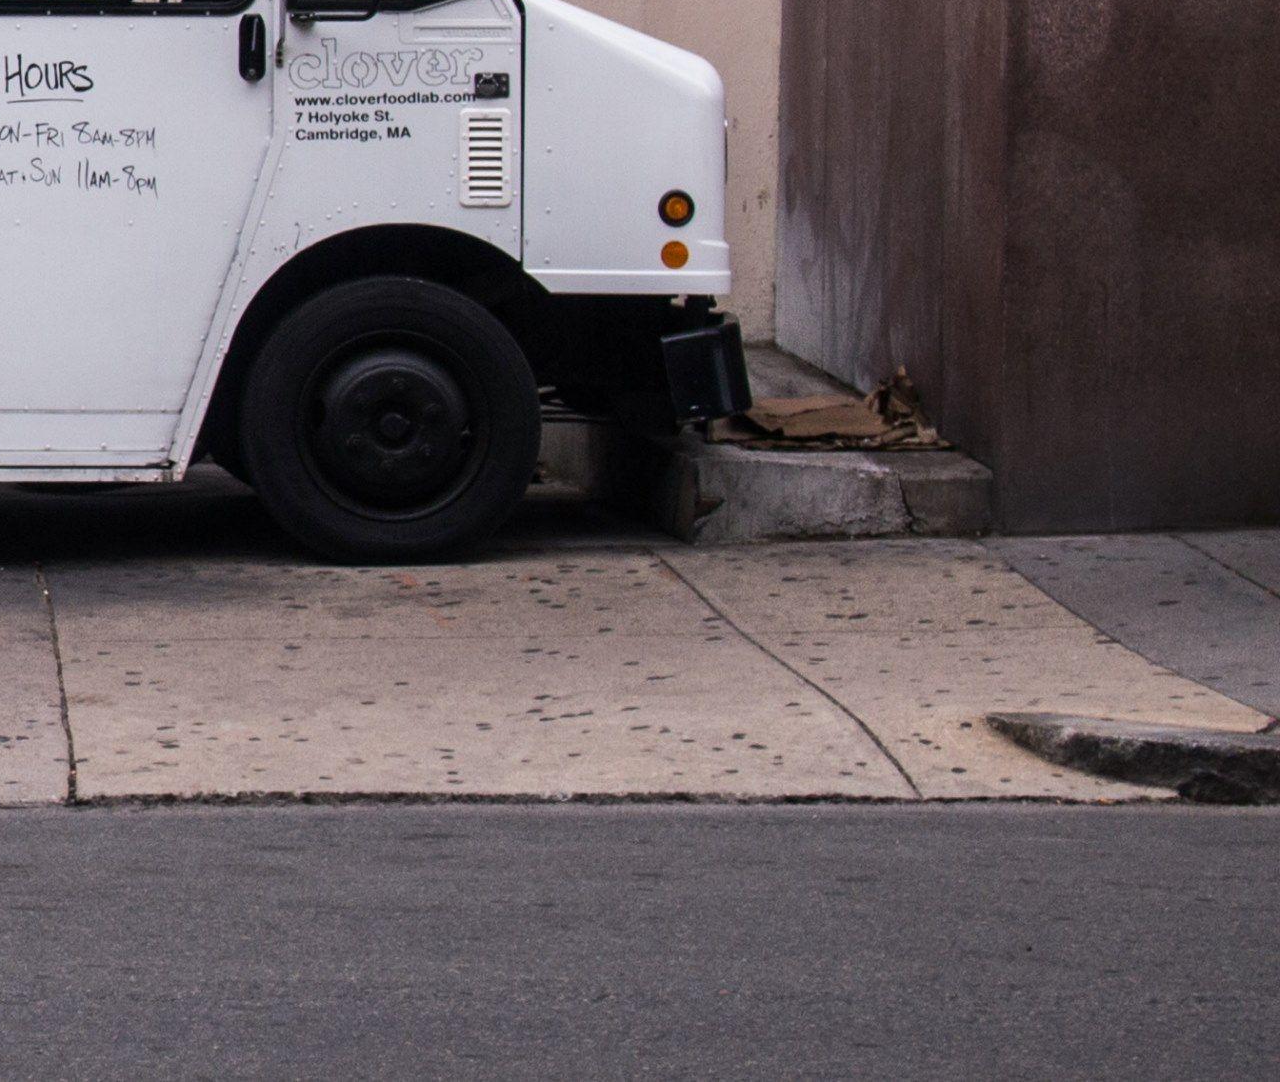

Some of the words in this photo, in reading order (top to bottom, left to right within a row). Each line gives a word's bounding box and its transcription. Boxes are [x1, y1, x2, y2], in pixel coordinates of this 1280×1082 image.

[289, 37, 484, 90] clover
[4, 53, 94, 97] HOURS
[295, 92, 477, 107] www.cloverfoodlab.com
[295, 113, 304, 124] 7
[308, 111, 370, 126] Holyoke
[374, 110, 394, 122] St.
[295, 127, 383, 143] Cambridge,
[387, 126, 412, 139] MA
